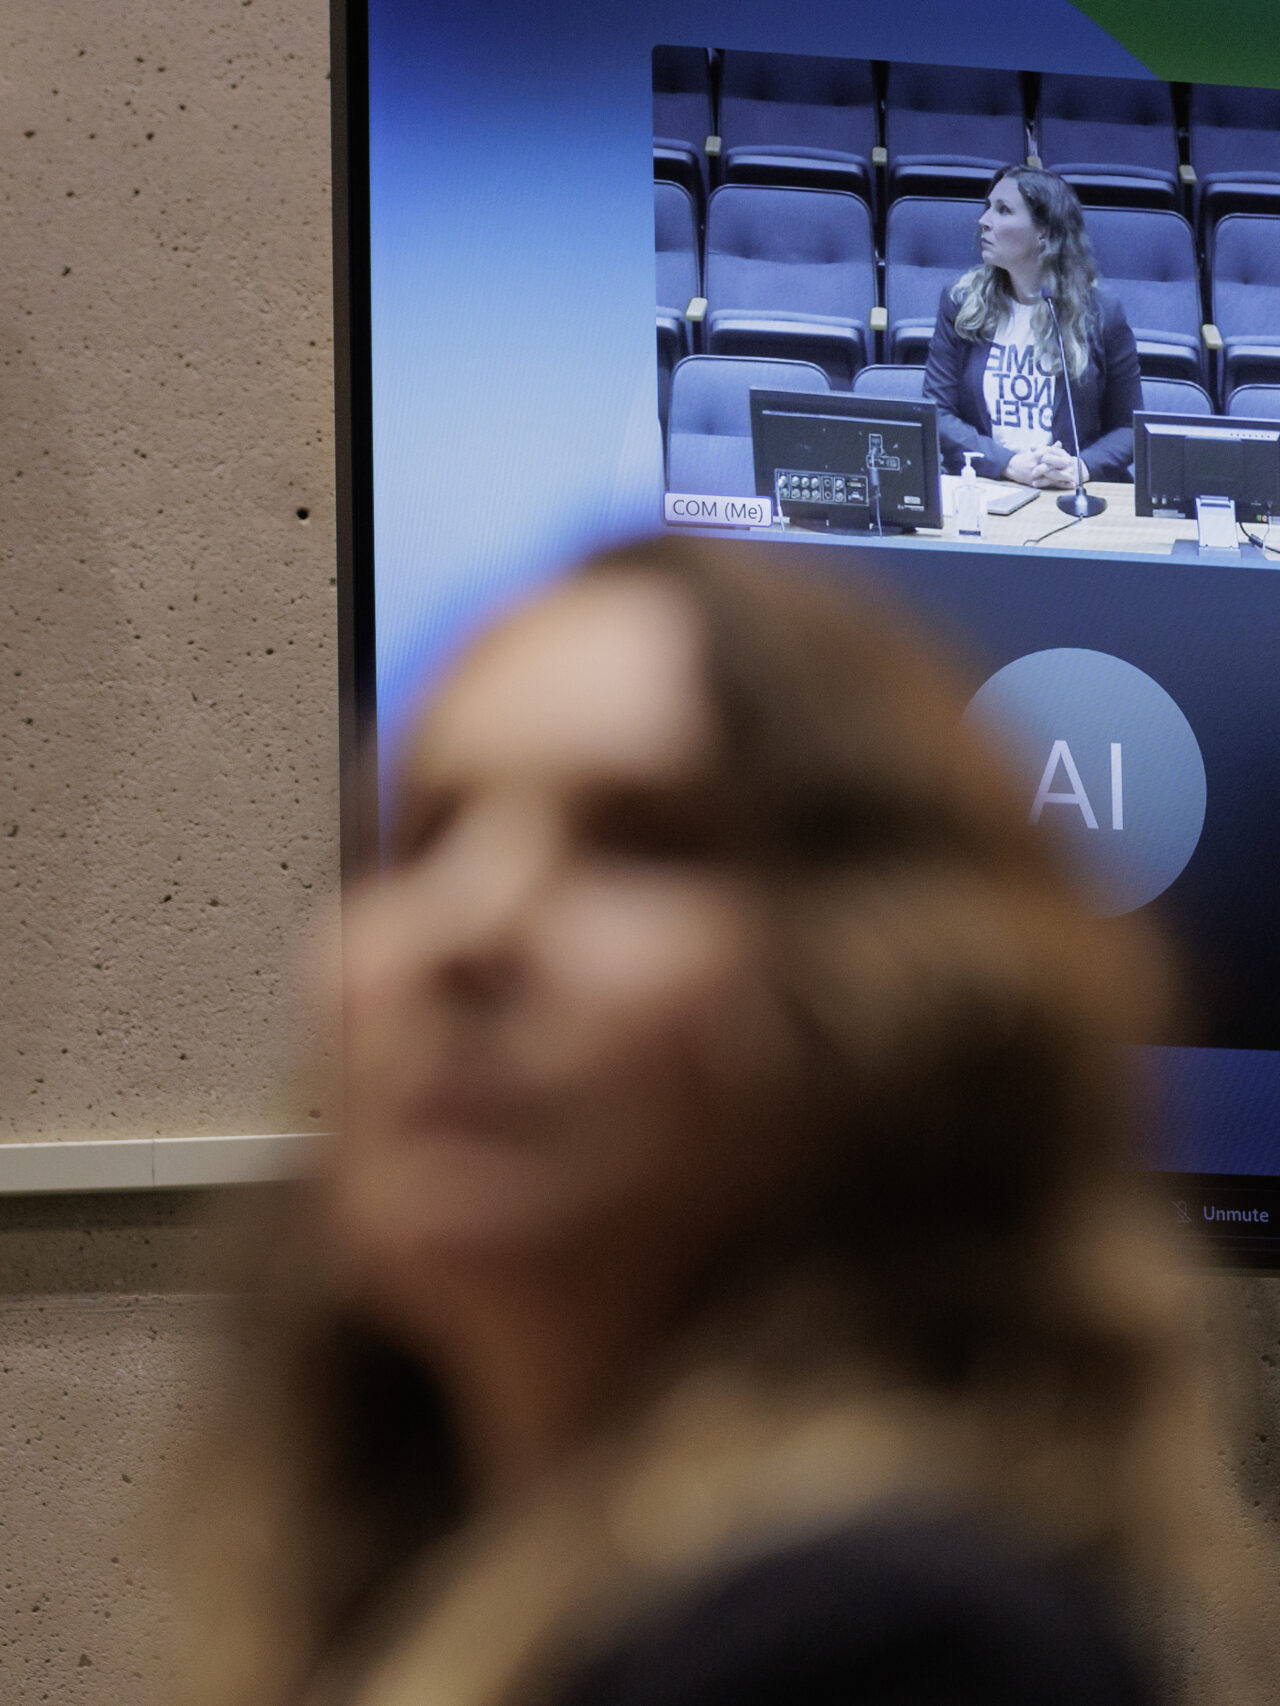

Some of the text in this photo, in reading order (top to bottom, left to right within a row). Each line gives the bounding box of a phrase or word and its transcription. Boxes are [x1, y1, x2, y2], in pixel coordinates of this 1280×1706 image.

[673, 499, 763, 523] COM (Me)
[1028, 739, 1124, 830] AI
[1203, 1206, 1269, 1222] Unmute
